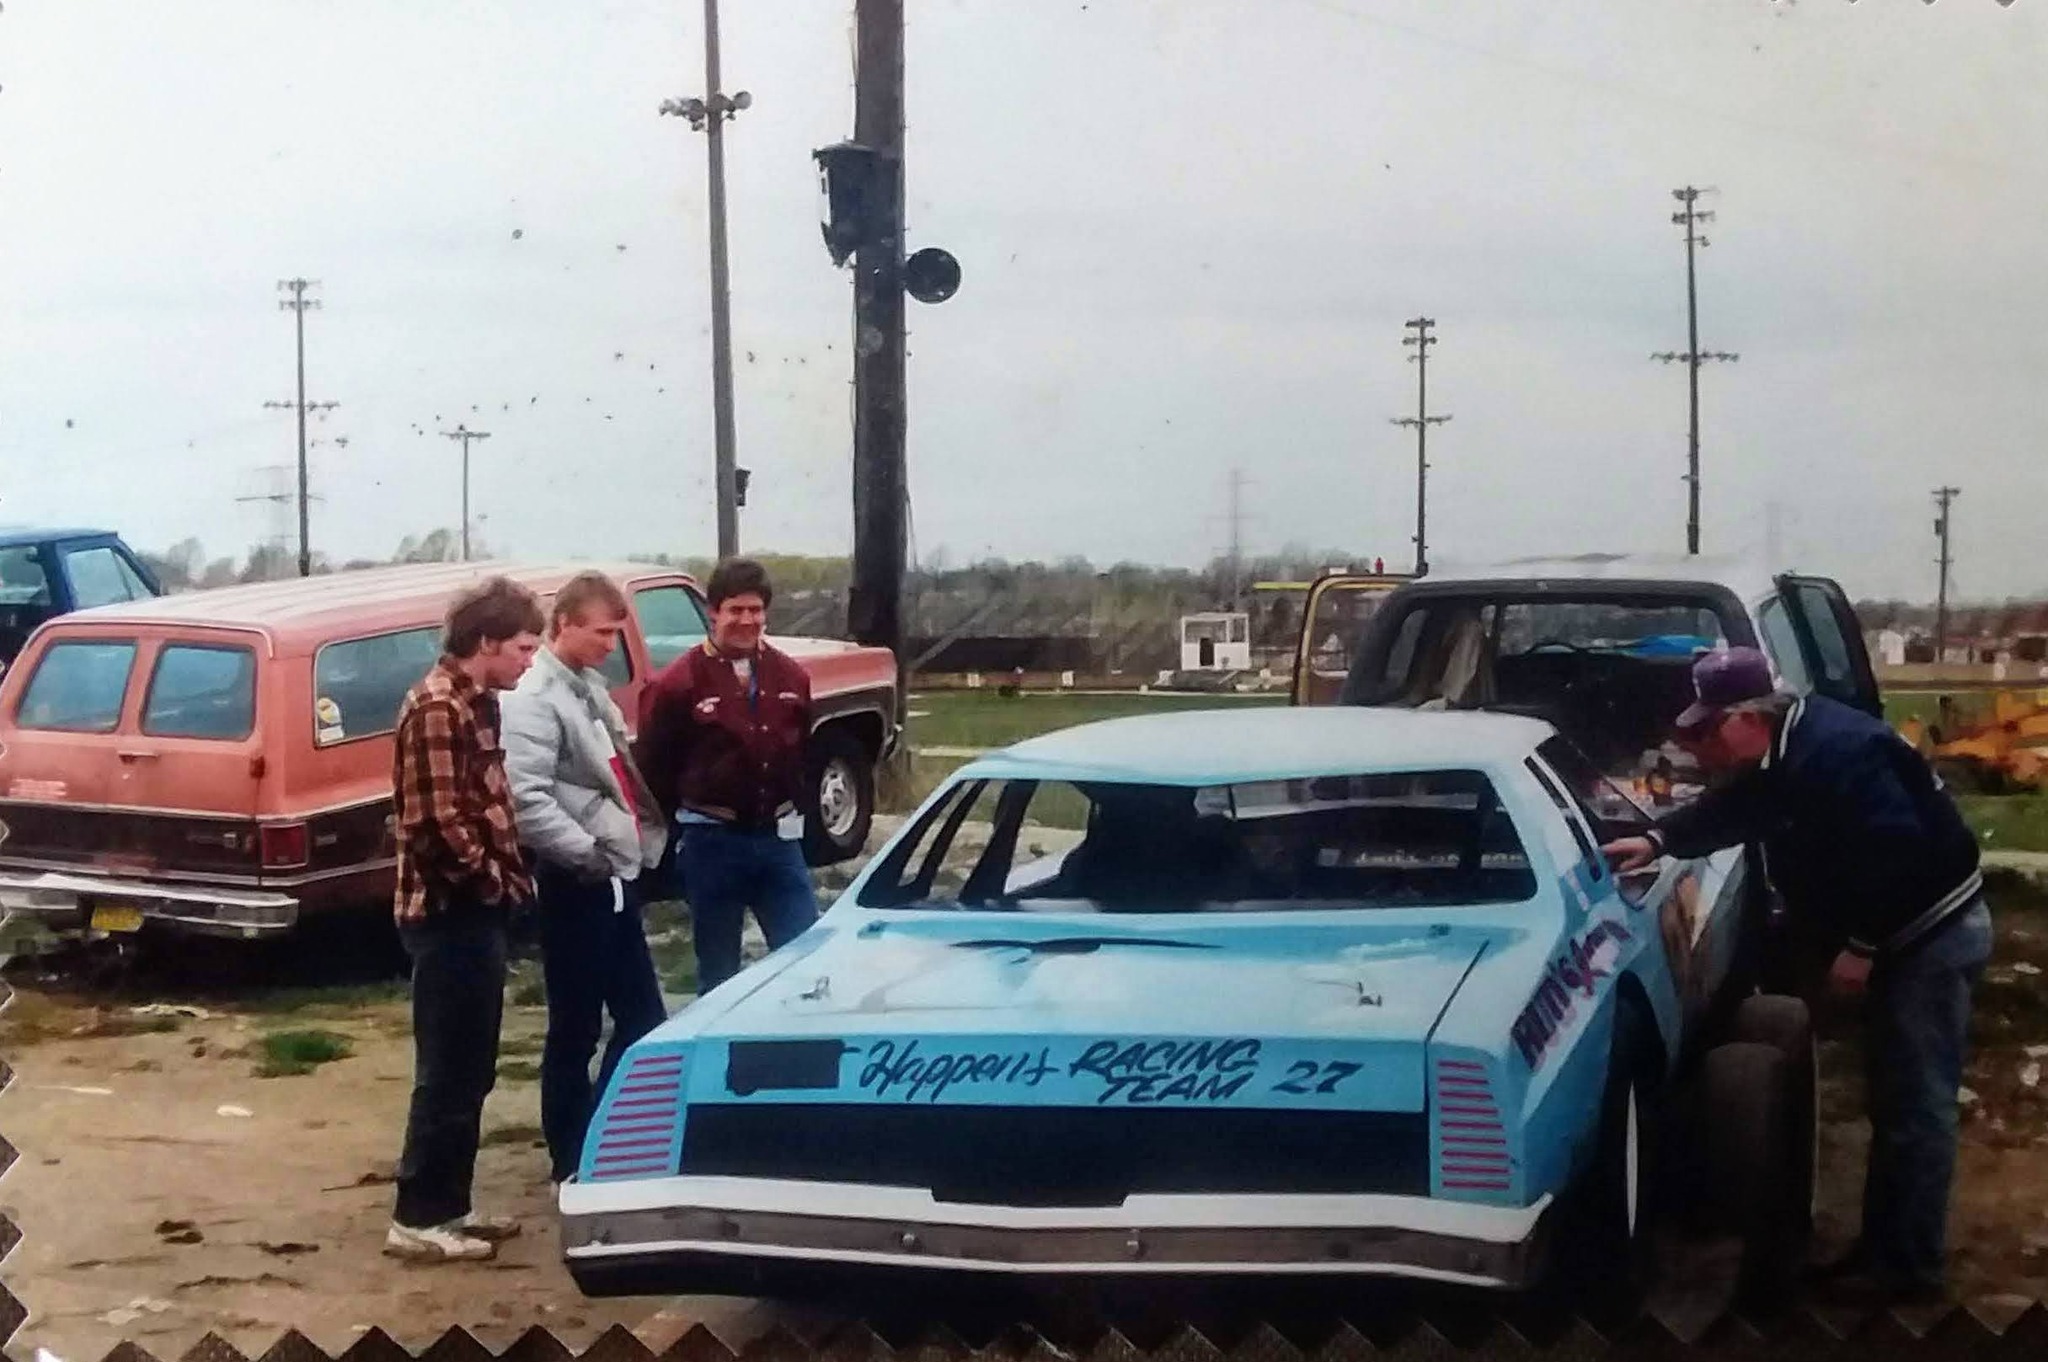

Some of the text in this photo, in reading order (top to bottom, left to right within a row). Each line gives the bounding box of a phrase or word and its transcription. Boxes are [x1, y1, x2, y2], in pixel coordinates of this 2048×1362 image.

[1069, 1038, 1262, 1079] RACING
[1097, 1071, 1255, 1104] TEAM
[1270, 1059, 1365, 1095] 27
